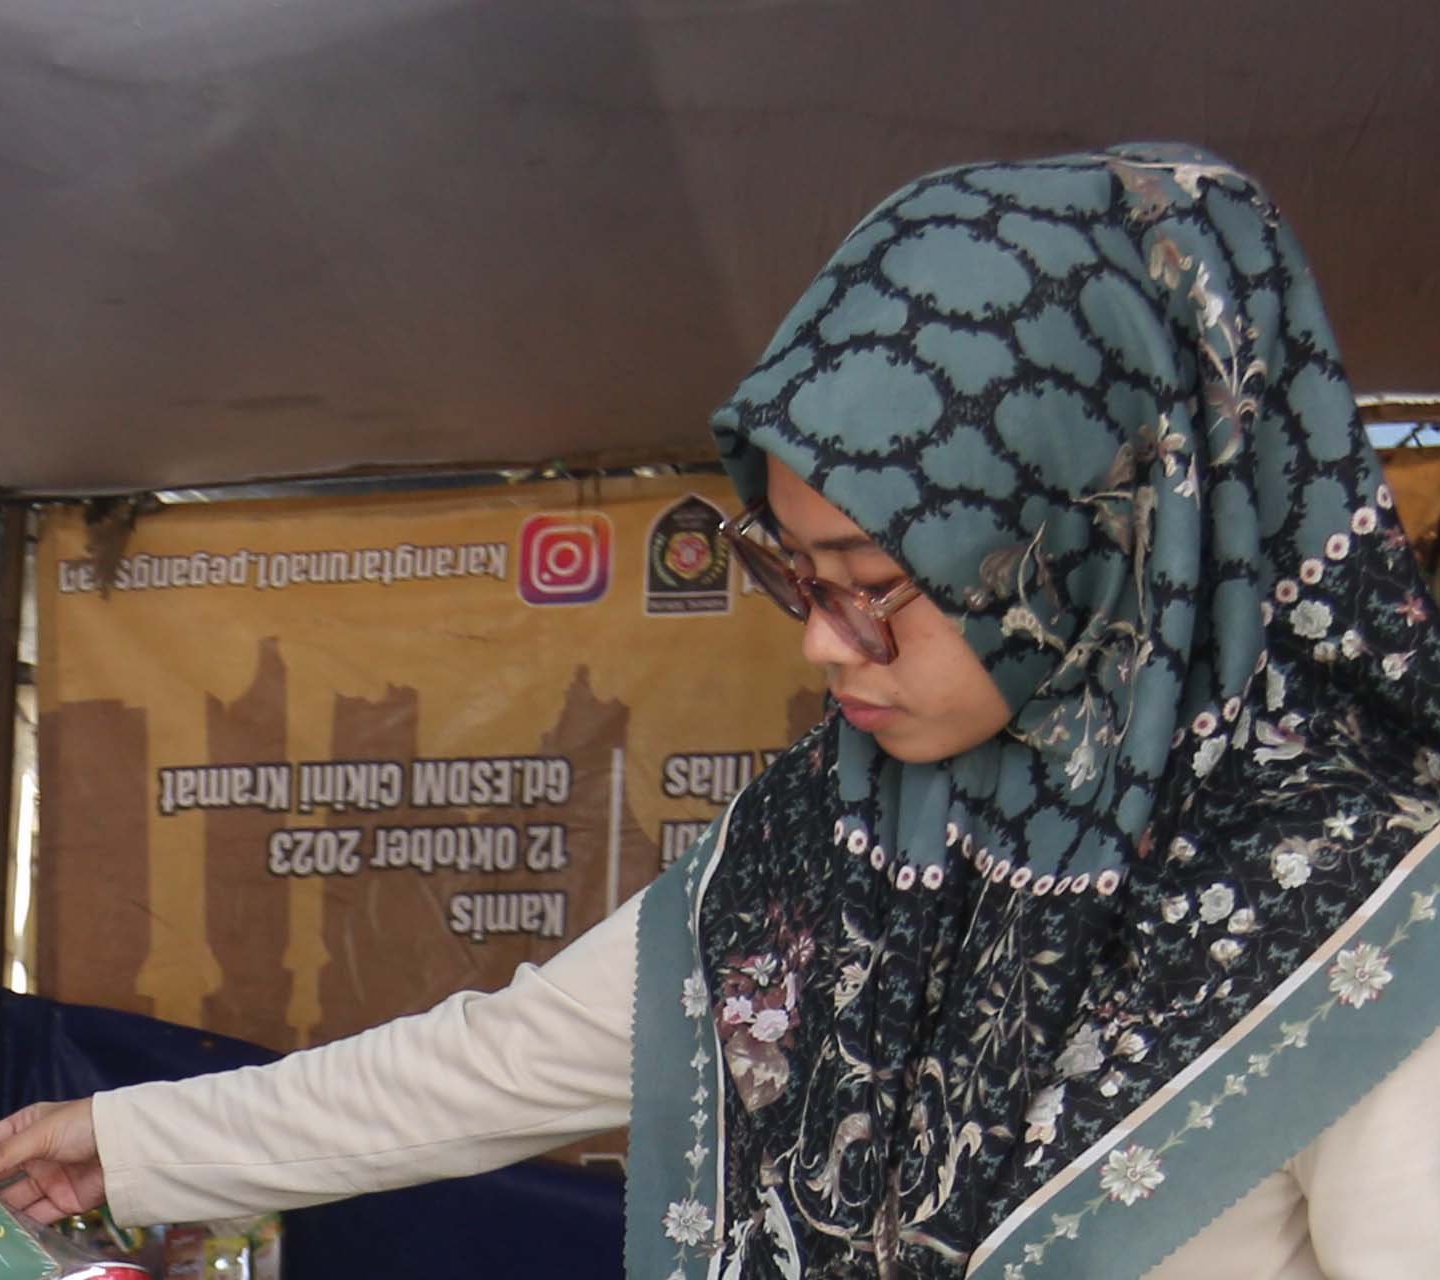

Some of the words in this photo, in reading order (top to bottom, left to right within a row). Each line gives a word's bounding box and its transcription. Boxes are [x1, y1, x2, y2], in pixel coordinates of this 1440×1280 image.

[58, 543, 510, 592] karangtaruna01.pegangsan
[161, 766, 292, 817] Kramat
[299, 763, 403, 813] Cikini
[412, 760, 571, 807] Gd.ESDM
[268, 830, 363, 876] 2023
[371, 826, 519, 874] Oktober
[525, 825, 564, 870] 12
[447, 892, 565, 938] Kamis
